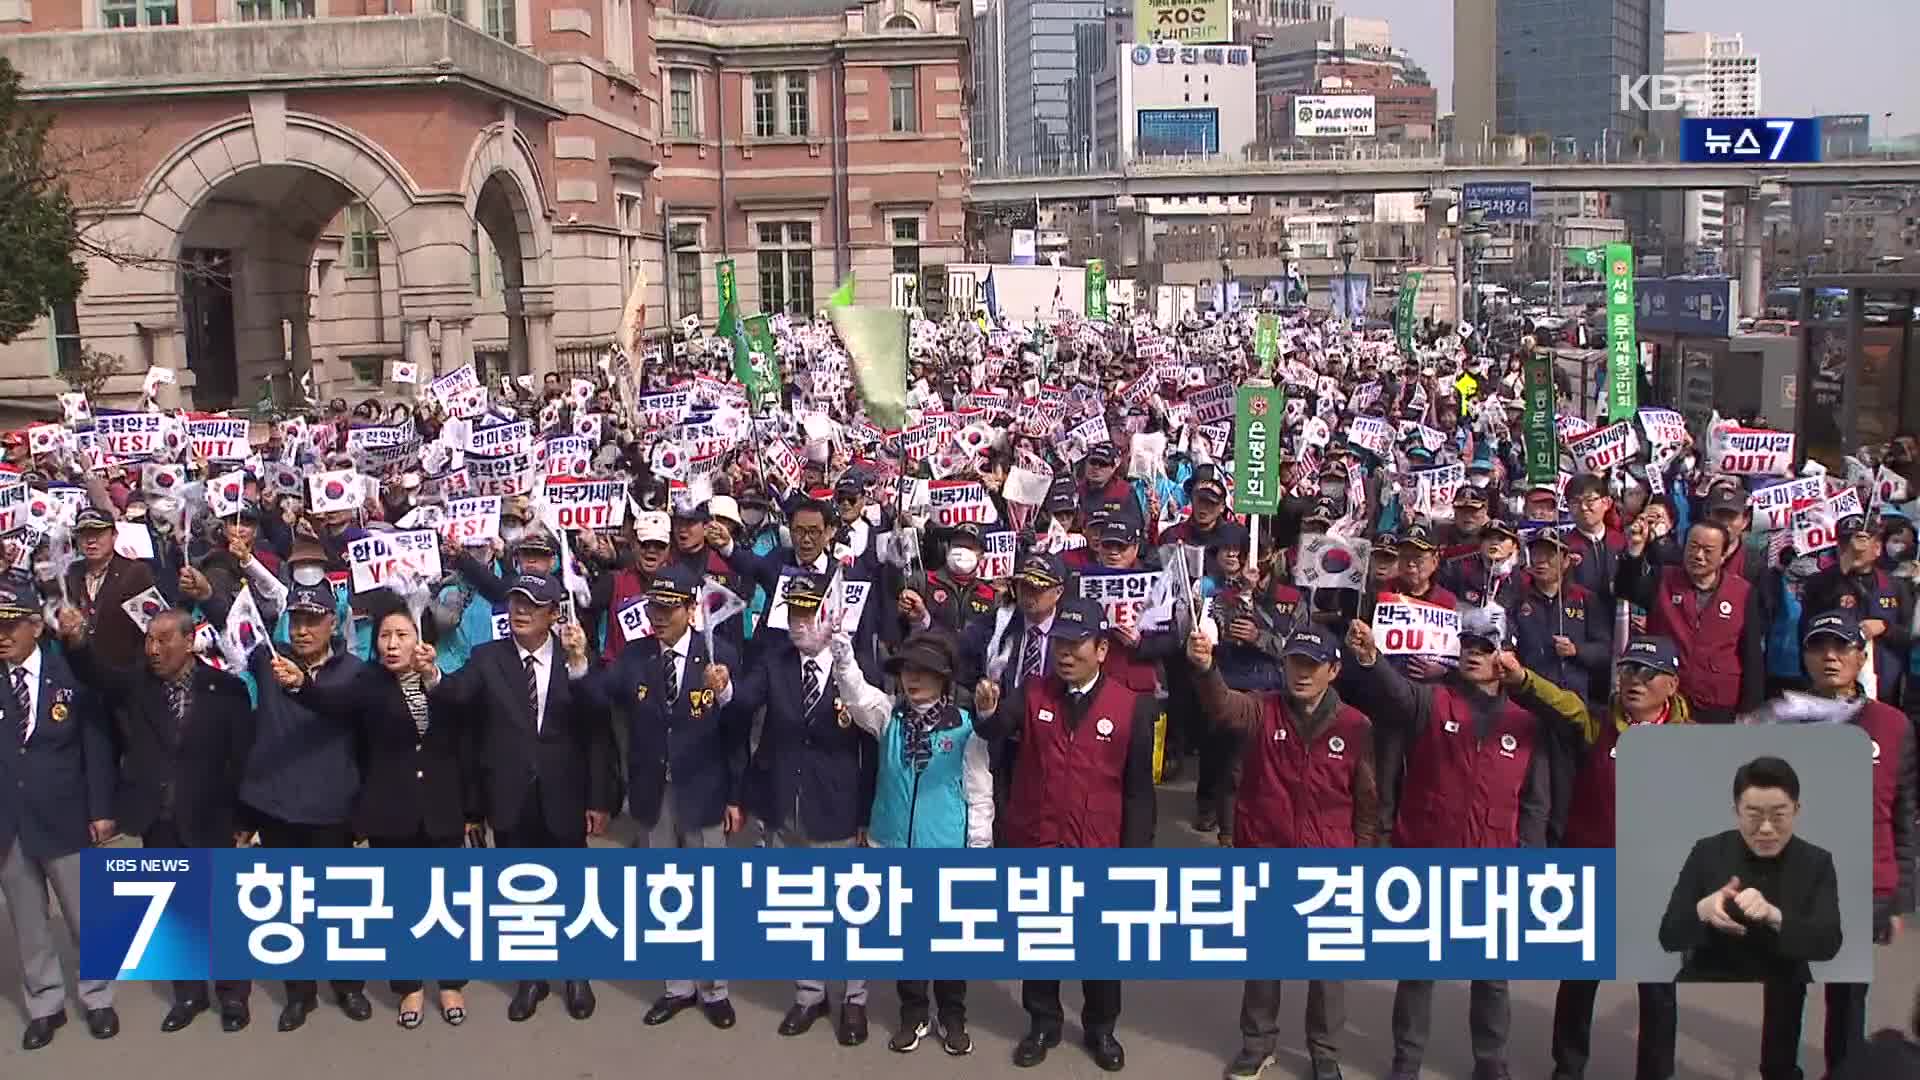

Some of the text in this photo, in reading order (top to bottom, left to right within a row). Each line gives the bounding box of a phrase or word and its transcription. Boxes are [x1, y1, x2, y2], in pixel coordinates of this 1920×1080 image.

[1315, 108, 1373, 119] DAEWON
[1613, 279, 1628, 305] 서울
[1196, 402, 1230, 420] OUT!
[107, 434, 152, 455] YES!
[472, 423, 527, 448] 한미동맹
[1247, 421, 1266, 498] 은평구회
[1584, 440, 1626, 471] OUT!
[1721, 455, 1777, 473] OUT!
[480, 475, 525, 497] YES!
[558, 506, 614, 529] OUT!
[938, 509, 987, 525] OUT!
